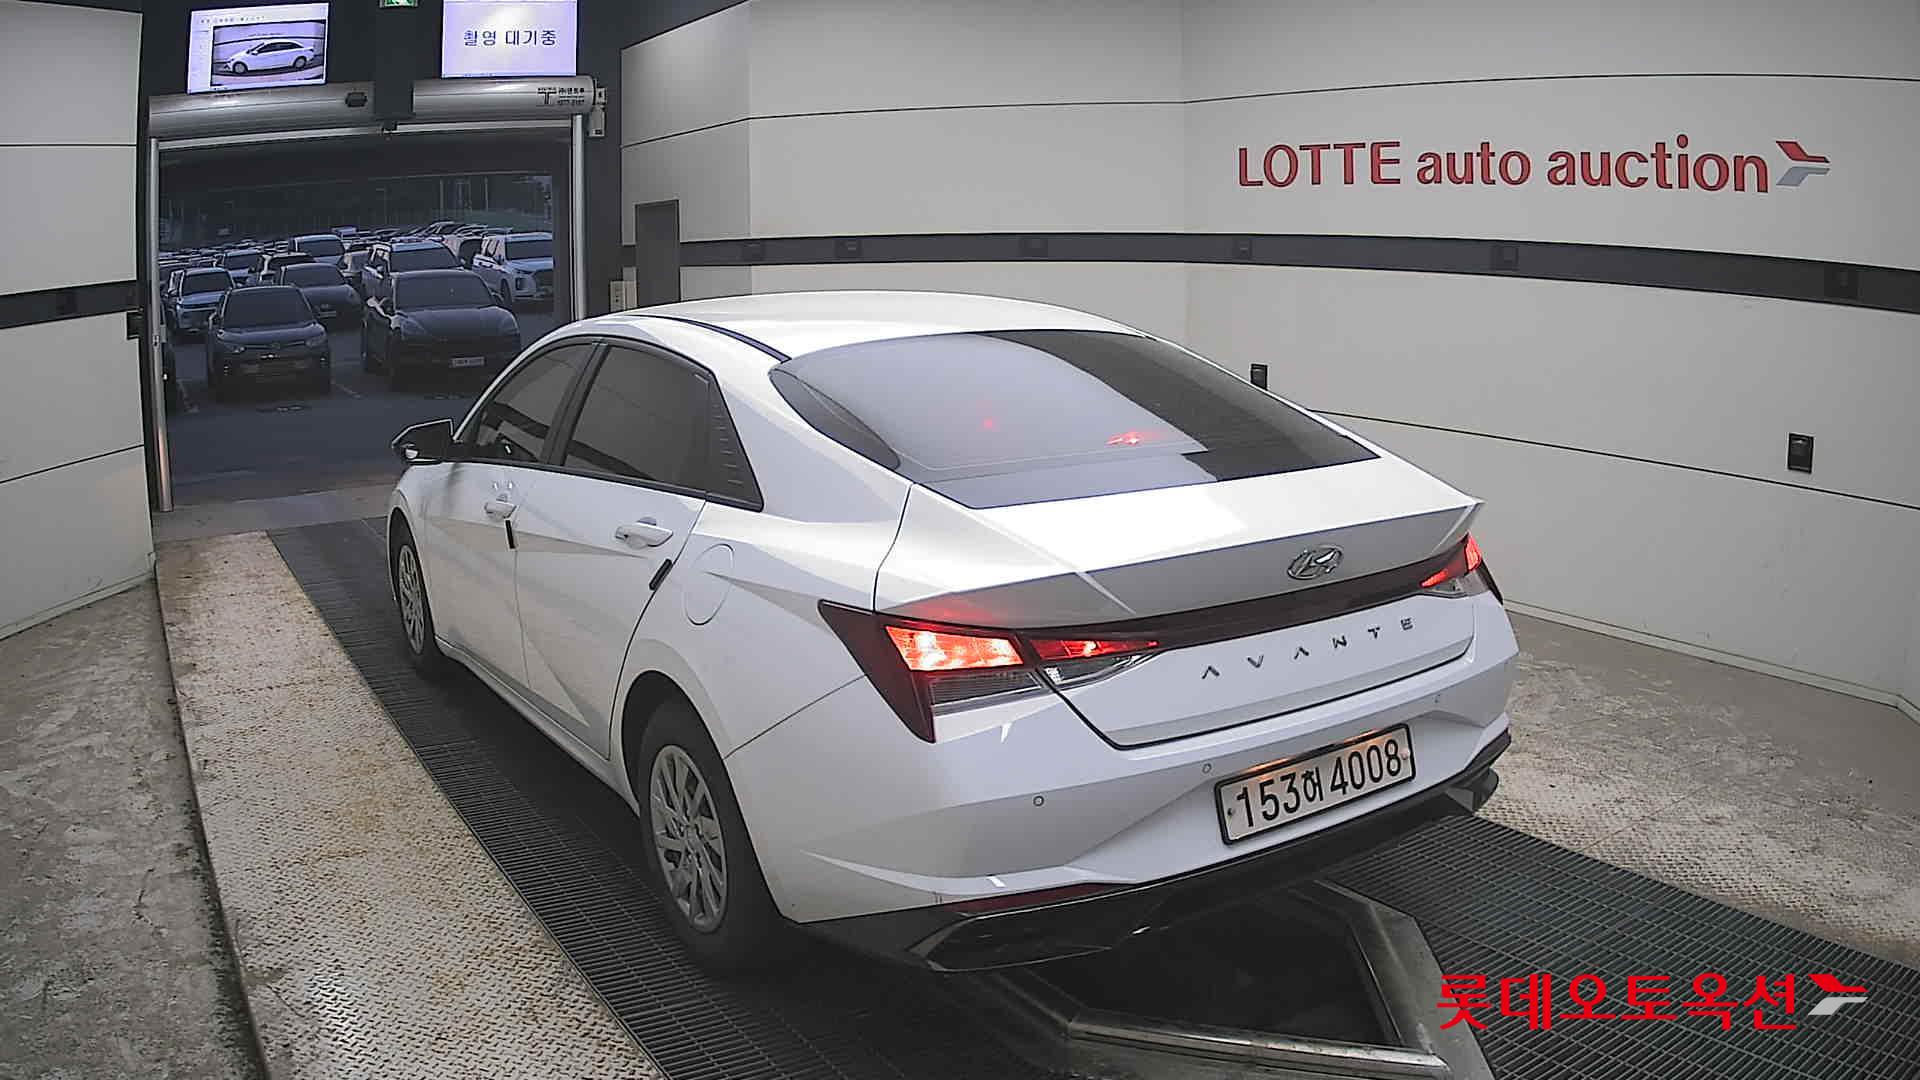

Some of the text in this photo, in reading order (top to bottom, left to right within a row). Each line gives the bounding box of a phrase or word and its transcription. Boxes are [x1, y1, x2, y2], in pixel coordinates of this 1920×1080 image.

[505, 30, 557, 46] 대기중
[1238, 134, 1770, 194] LOTTE auto auction
[1201, 616, 1414, 681] AVANTE
[1329, 738, 1403, 796] 4008
